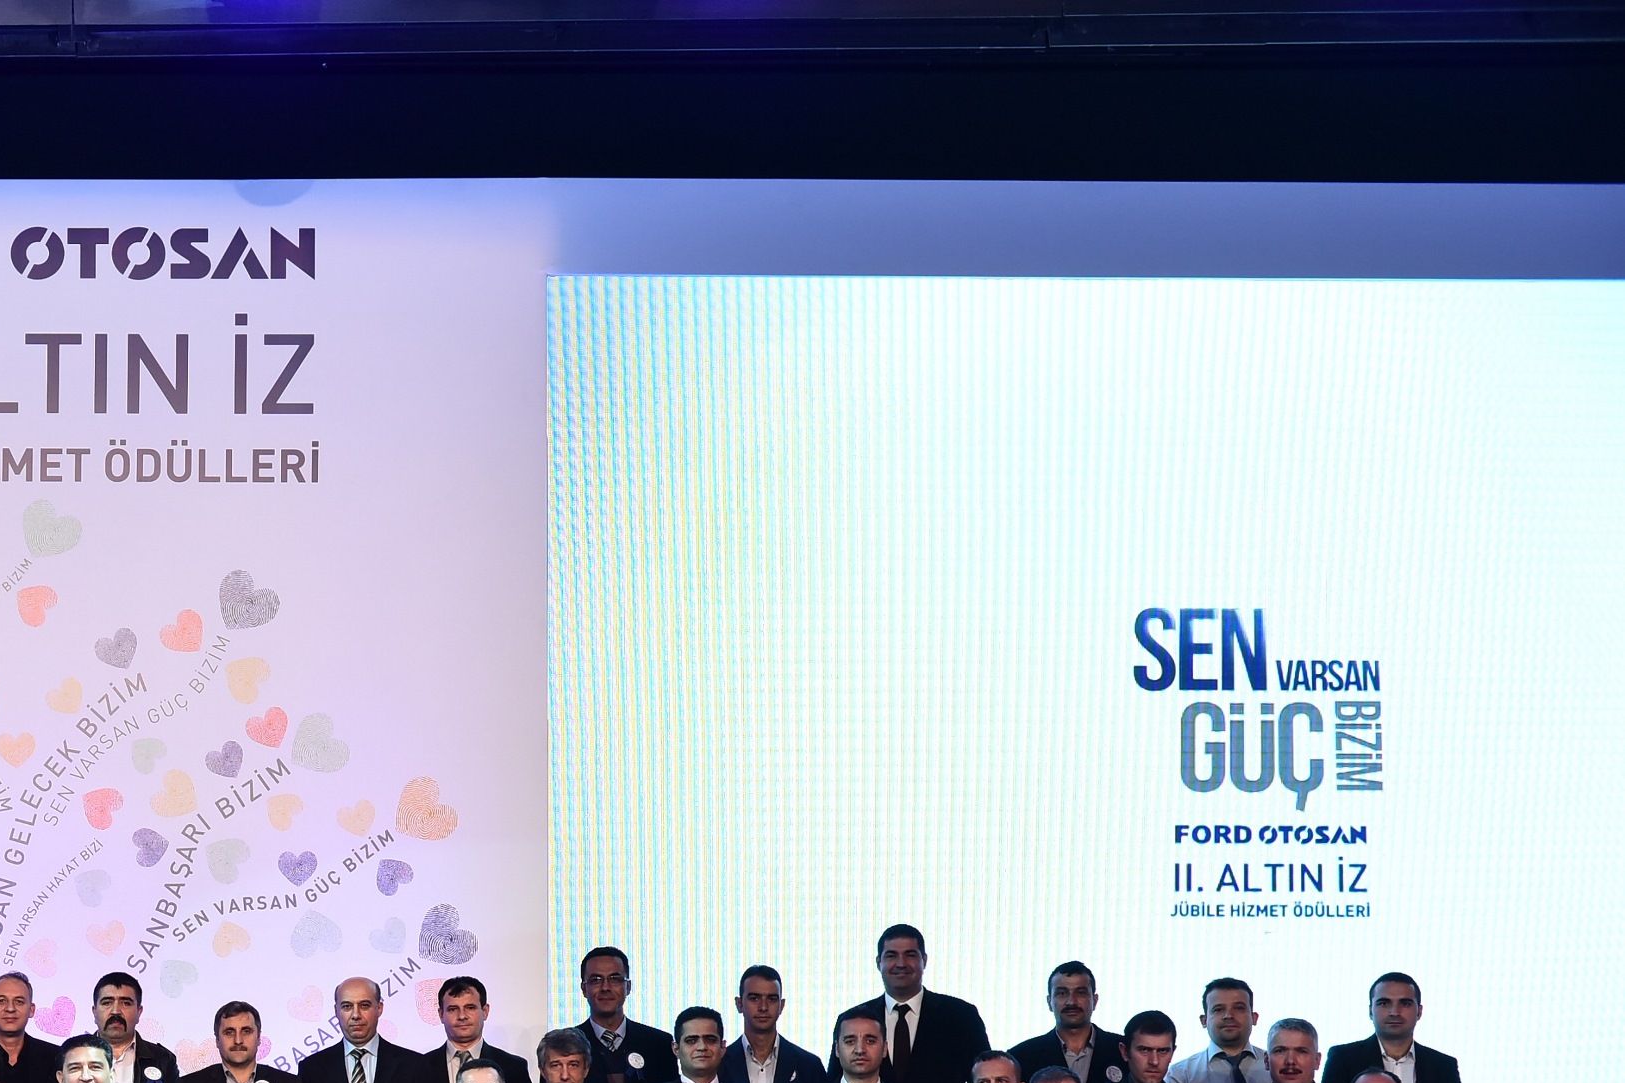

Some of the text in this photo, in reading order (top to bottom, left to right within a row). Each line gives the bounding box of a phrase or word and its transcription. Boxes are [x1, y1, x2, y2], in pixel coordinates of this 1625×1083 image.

[10, 226, 316, 281] OTOSAN
[234, 313, 316, 415] İZ
[104, 440, 321, 484] ÖDÜLLERİ
[1, 557, 33, 592] BİZİM
[1133, 607, 1381, 692] SEN VARSAN
[3, 738, 81, 868] GELECEK
[75, 672, 149, 739] BİZİM
[43, 634, 231, 827] SEN VARSAN GÜÇ BİZİM
[1180, 701, 1324, 812] GÜÇ
[1335, 700, 1383, 791] BİZİM
[214, 757, 293, 820] BİZİM
[1174, 825, 1367, 845] FORD OTOSAN
[1174, 856, 1368, 892] II. ALTIN İZ
[3, 941, 22, 966] SEN
[13, 893, 49, 939] VARSAN
[46, 857, 80, 895] HAYAT
[172, 829, 396, 943] SEN VARSAN GÜÇ BİZİM
[1171, 901, 1370, 917] JÜBİLE HİZMET ÖDÜLLERİ
